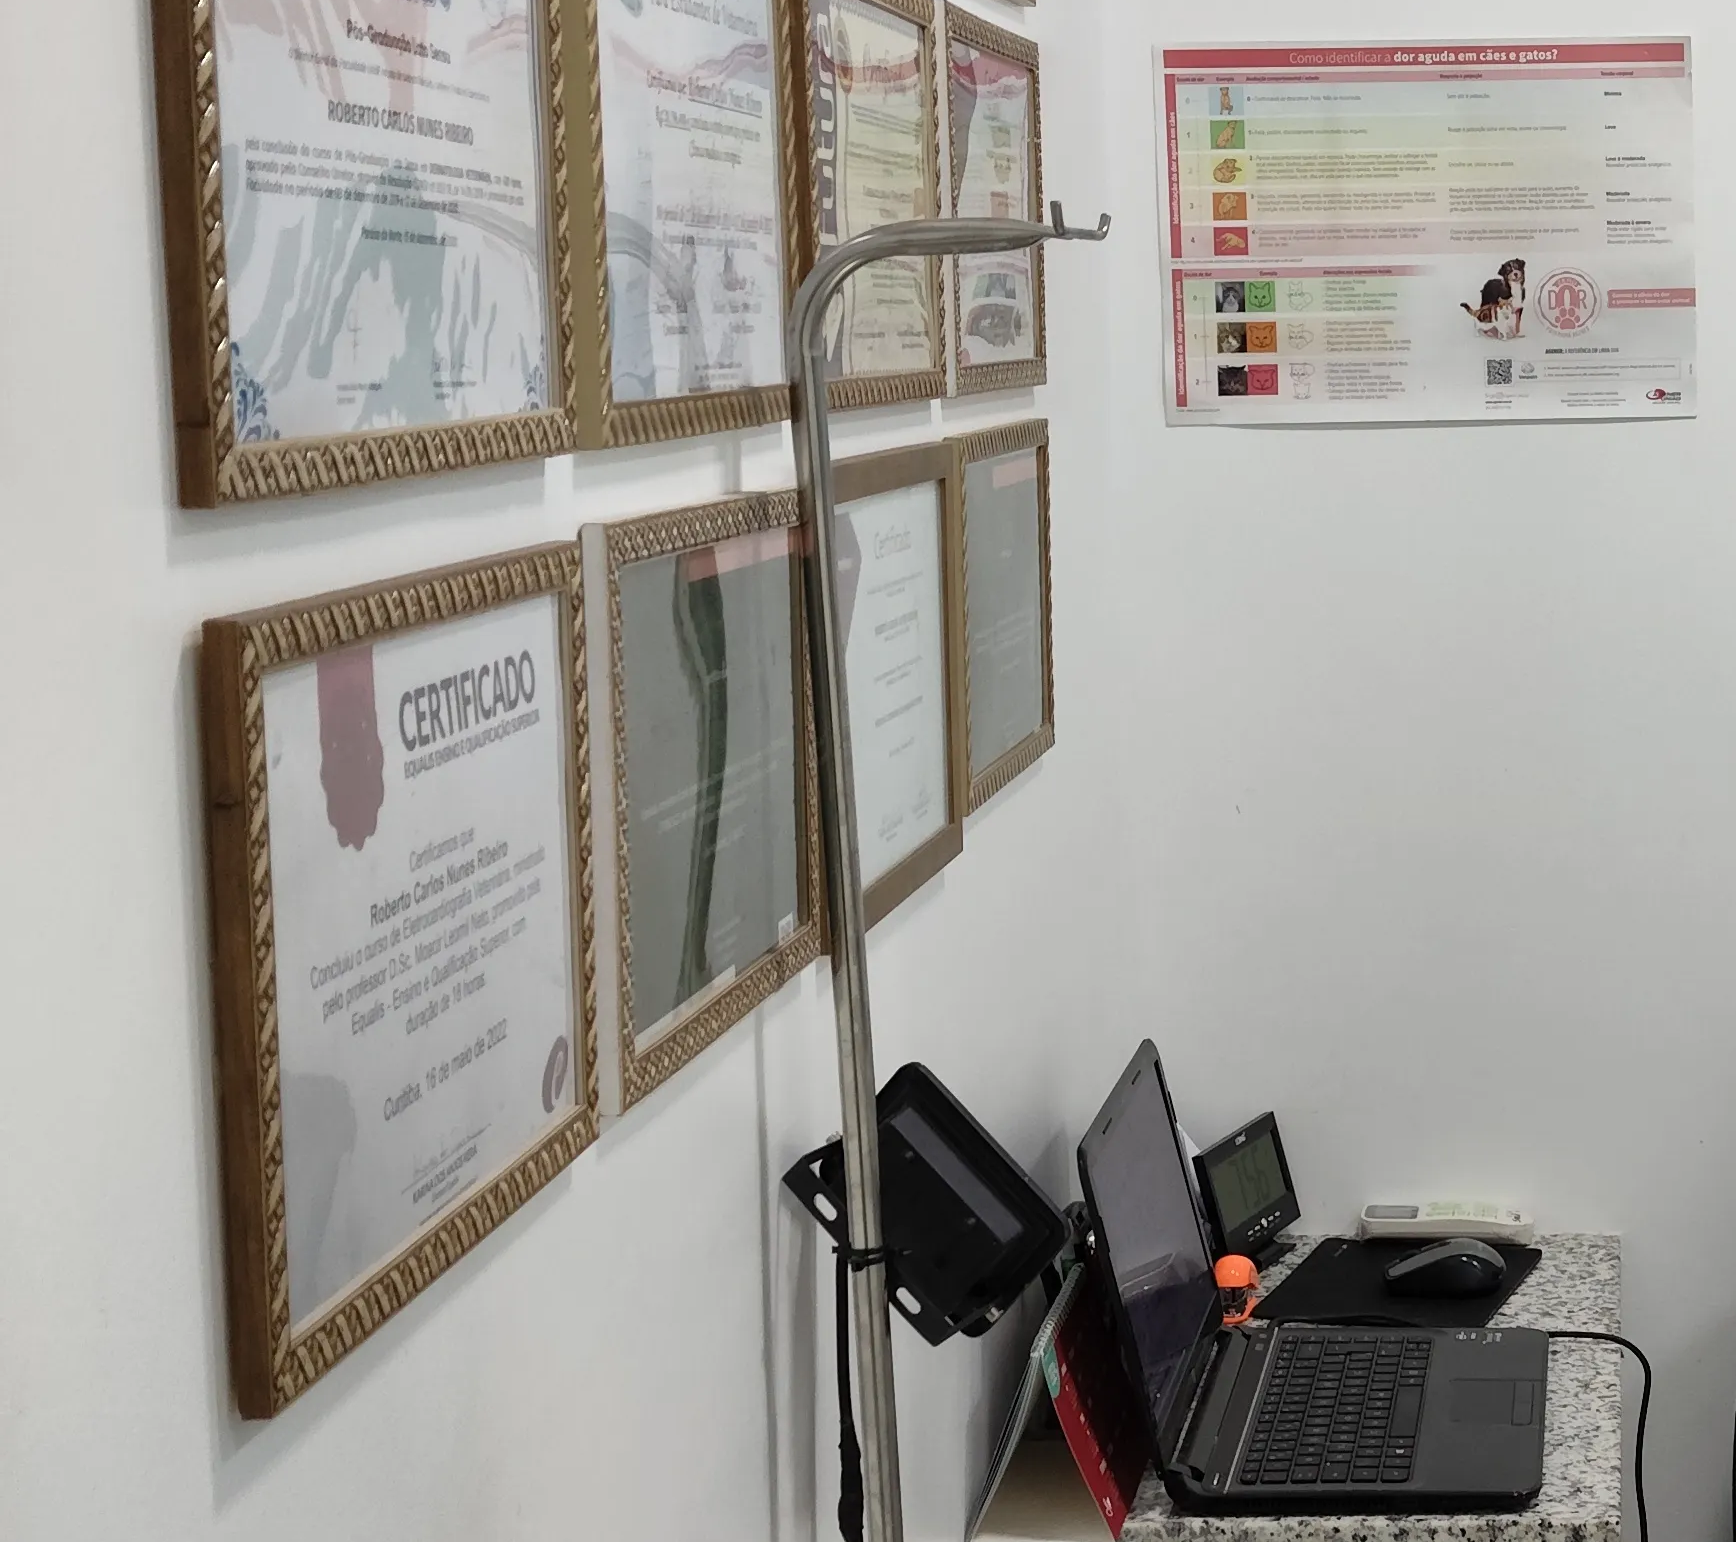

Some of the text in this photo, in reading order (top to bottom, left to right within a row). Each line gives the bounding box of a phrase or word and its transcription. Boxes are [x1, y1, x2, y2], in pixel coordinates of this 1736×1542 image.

[1289, 49, 1558, 64] Como identificar a dor aguda em cães e gatos?
[326, 99, 473, 146] ROBERTO CARLOS NUNES RIBEIRO
[397, 650, 536, 753] CERTIFICADO
[369, 837, 508, 928] Roberto Carlos Nunes Ribeiro
